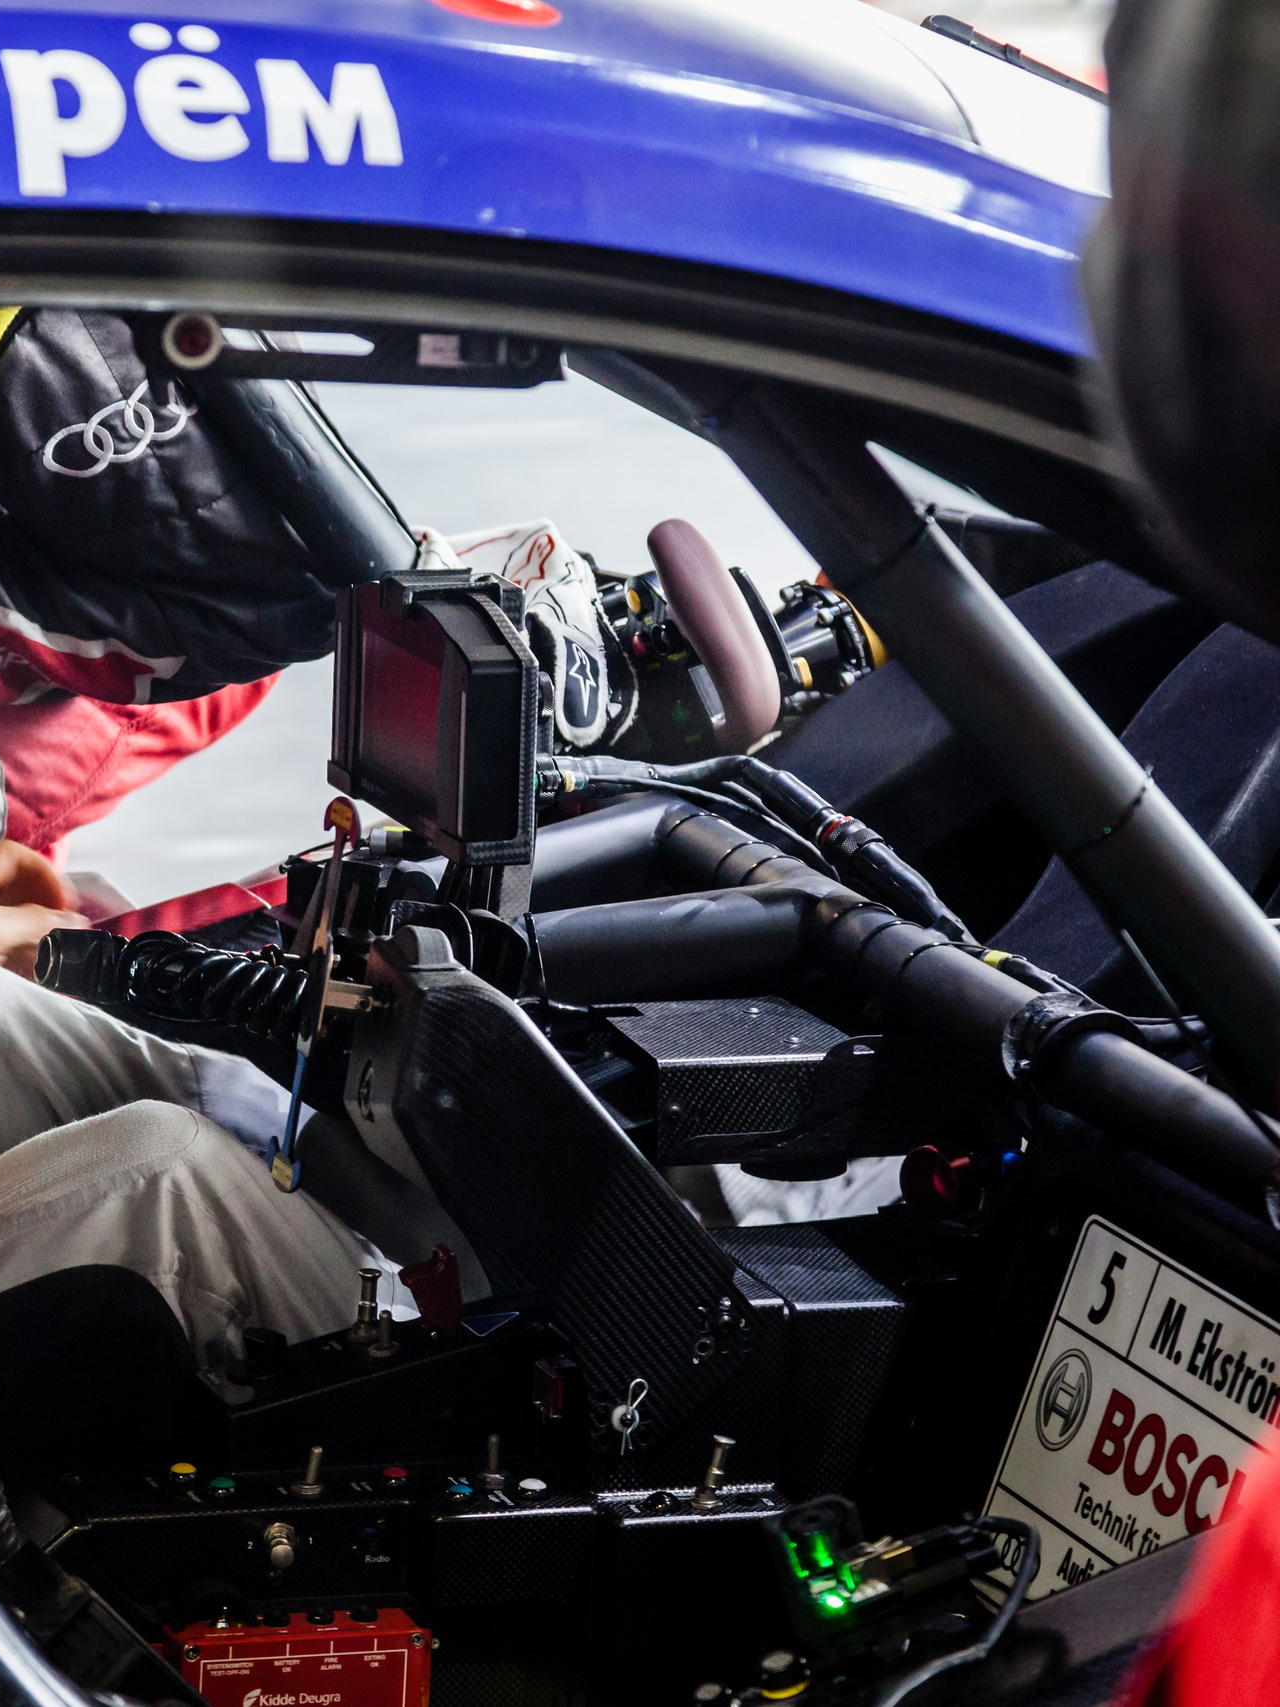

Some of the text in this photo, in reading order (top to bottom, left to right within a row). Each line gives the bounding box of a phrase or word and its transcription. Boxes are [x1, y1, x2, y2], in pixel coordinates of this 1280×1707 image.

[1087, 1251, 1128, 1326] 5
[1149, 1296, 1188, 1366] M.
[1074, 1482, 1162, 1557] Technik fü
[364, 1554, 391, 1564] Radio
[273, 1659, 301, 1667] BATTERY
[323, 1656, 339, 1664] FIRE
[320, 1663, 342, 1671] ALARM
[259, 1692, 342, 1707] Kidde Deugra
